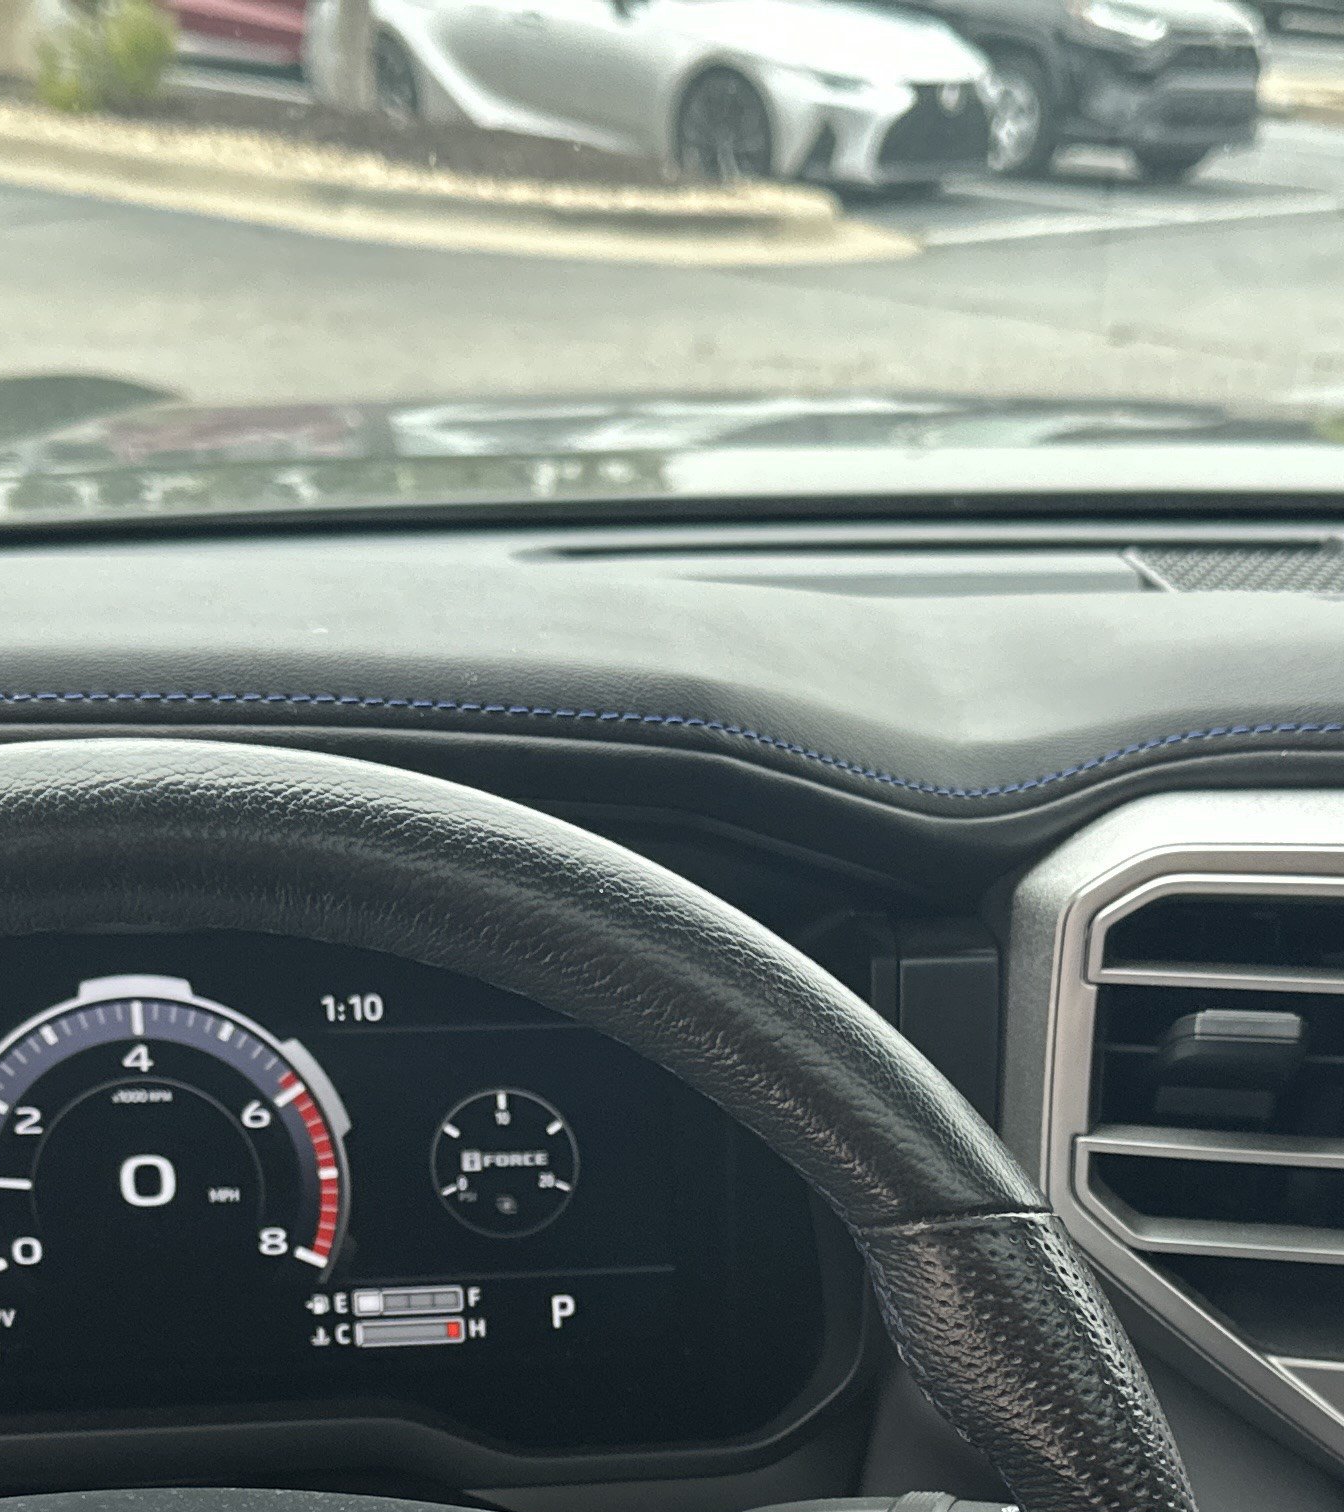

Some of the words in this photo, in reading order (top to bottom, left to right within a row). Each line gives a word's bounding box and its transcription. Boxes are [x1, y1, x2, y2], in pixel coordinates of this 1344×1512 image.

[321, 995, 384, 1023] 1:10
[122, 1044, 154, 1073] 4
[13, 1106, 44, 1136] 2
[241, 1100, 271, 1129] 6
[494, 1109, 511, 1126] 10
[119, 1154, 176, 1207] 0
[208, 1187, 240, 1203] MPH
[538, 1171, 555, 1189] 20
[10, 1236, 44, 1265] 0
[258, 1228, 289, 1256] 8
[333, 1292, 348, 1314] E
[467, 1286, 481, 1308] F
[551, 1294, 576, 1330] P
[334, 1323, 351, 1345] C
[468, 1318, 486, 1338] H
